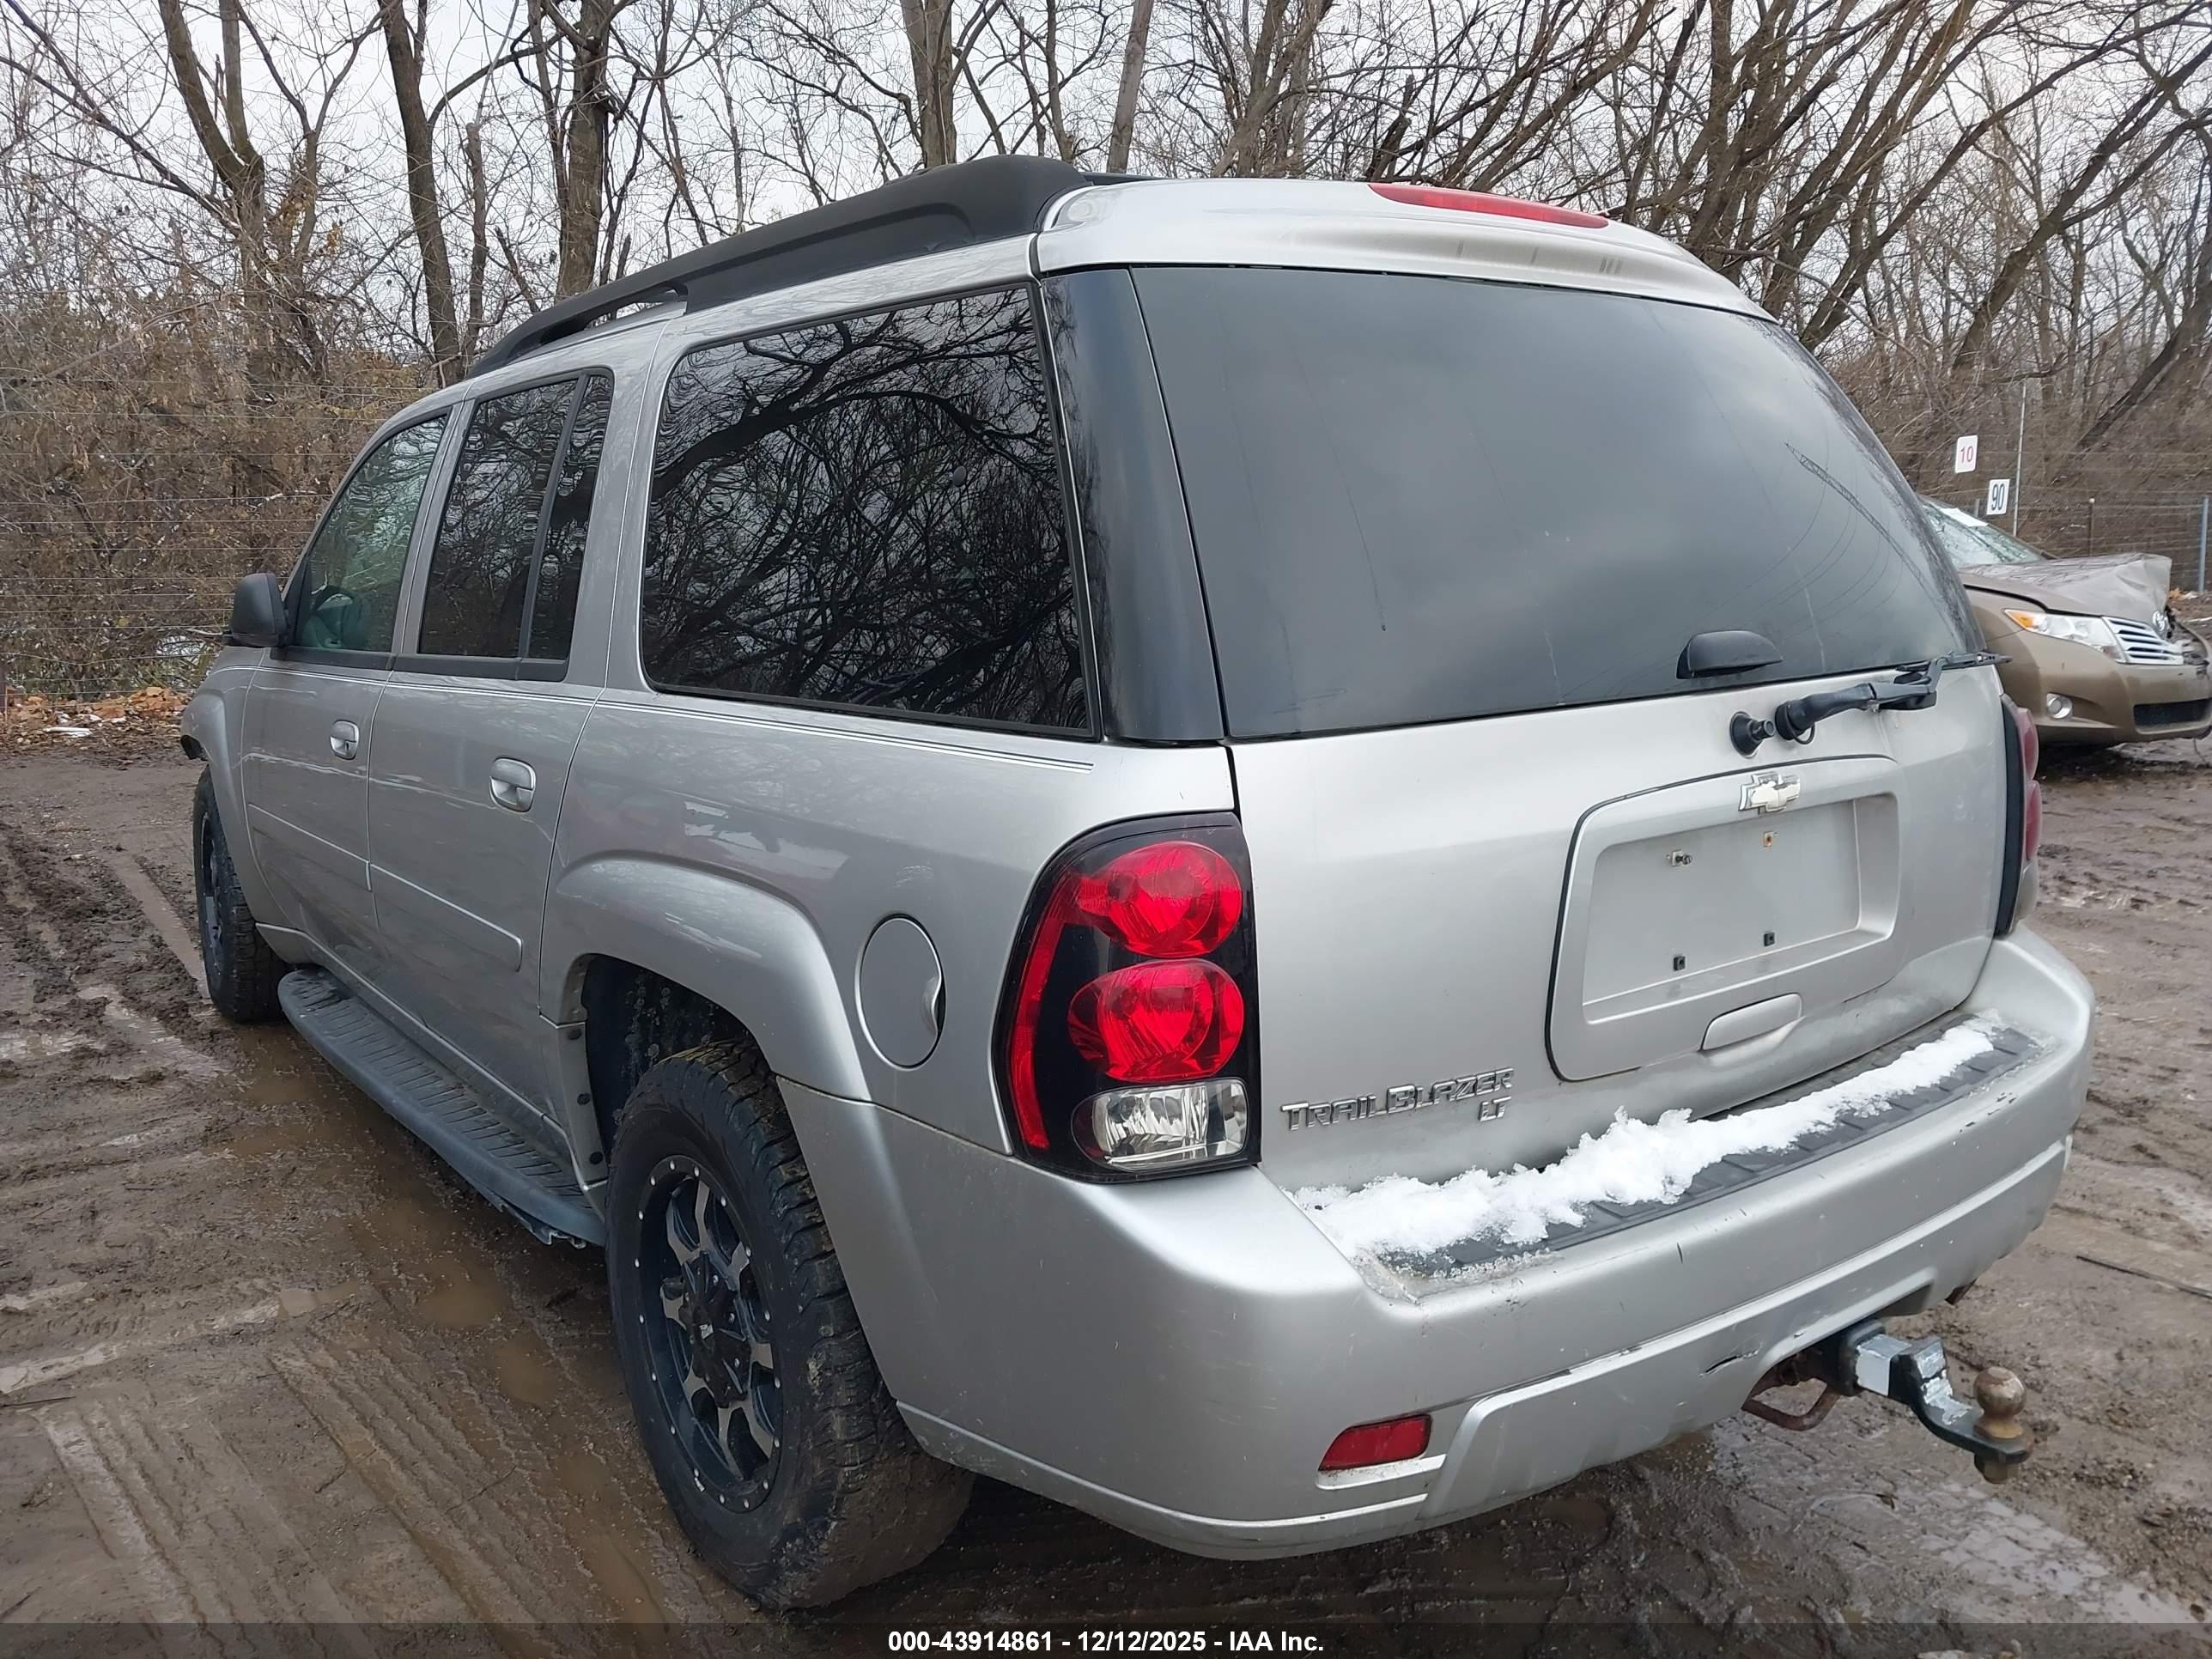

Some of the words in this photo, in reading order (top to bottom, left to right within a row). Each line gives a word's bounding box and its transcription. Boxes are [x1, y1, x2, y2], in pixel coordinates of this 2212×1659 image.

[1960, 445, 1974, 464] 10
[1990, 483, 2006, 512] 90
[1280, 1066, 1514, 1131] TRAILBLAZER
[1479, 1096, 1512, 1122] LT
